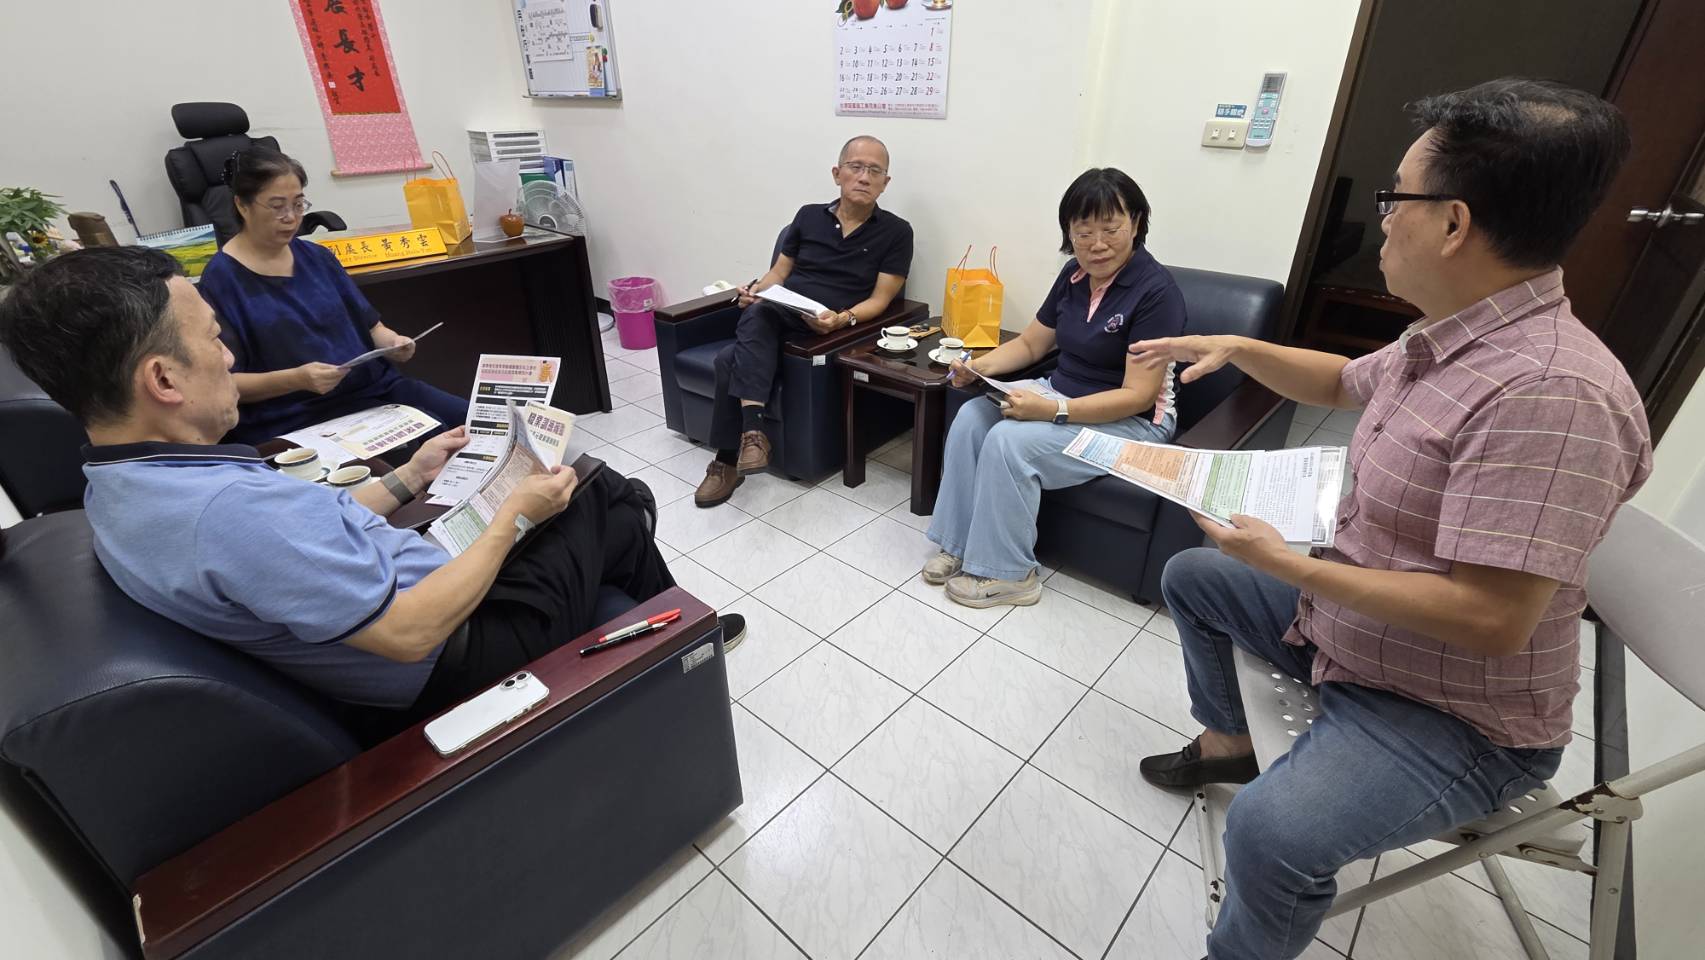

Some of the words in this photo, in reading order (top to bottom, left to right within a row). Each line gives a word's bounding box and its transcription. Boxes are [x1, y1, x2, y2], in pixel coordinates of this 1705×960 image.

[883, 44, 888, 53] 5
[898, 44, 902, 53] 6
[914, 43, 918, 52] 7
[929, 43, 933, 51] 8
[882, 59, 888, 67] 12
[896, 59, 902, 67] 13
[912, 58, 918, 67] 14
[928, 58, 935, 66] 15
[867, 74, 872, 82] 18
[881, 73, 887, 81] 19
[896, 73, 902, 81] 20
[911, 73, 918, 81] 21
[926, 73, 933, 81] 22
[866, 87, 872, 95] 25
[880, 87, 887, 95] 26
[896, 87, 903, 95] 27
[910, 87, 918, 95] 28
[926, 87, 933, 95] 29
[380, 234, 429, 252] 黃秀雲
